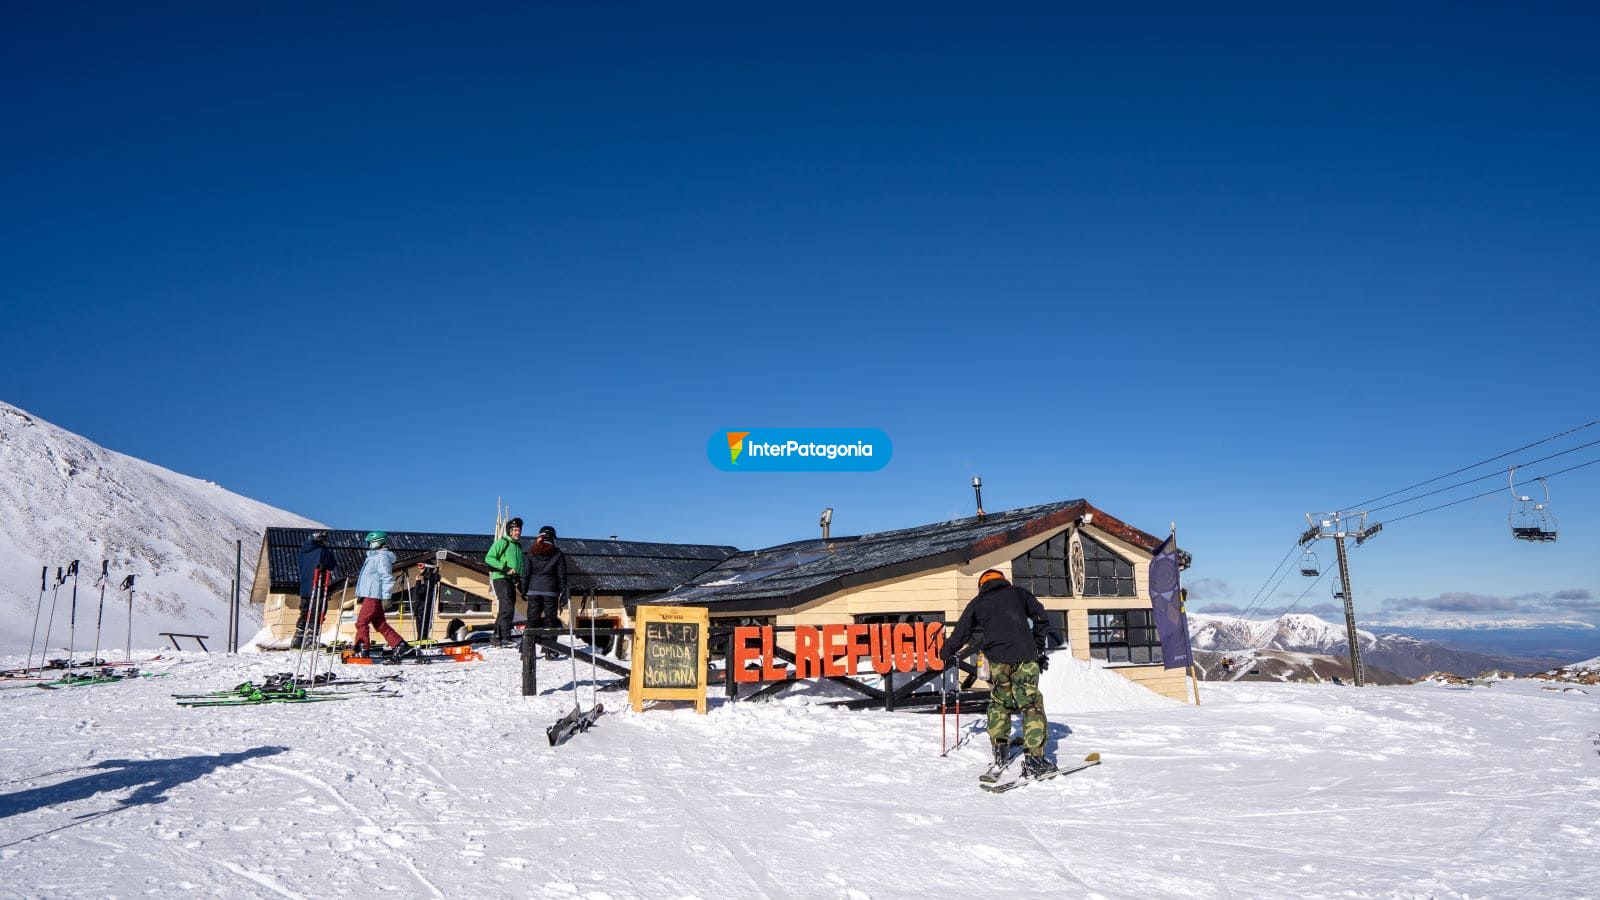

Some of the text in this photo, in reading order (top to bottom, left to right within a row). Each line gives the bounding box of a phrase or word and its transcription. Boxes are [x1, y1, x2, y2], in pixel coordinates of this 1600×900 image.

[652, 644, 692, 661] COMIDA
[734, 621, 945, 683] EL REFUGIO
